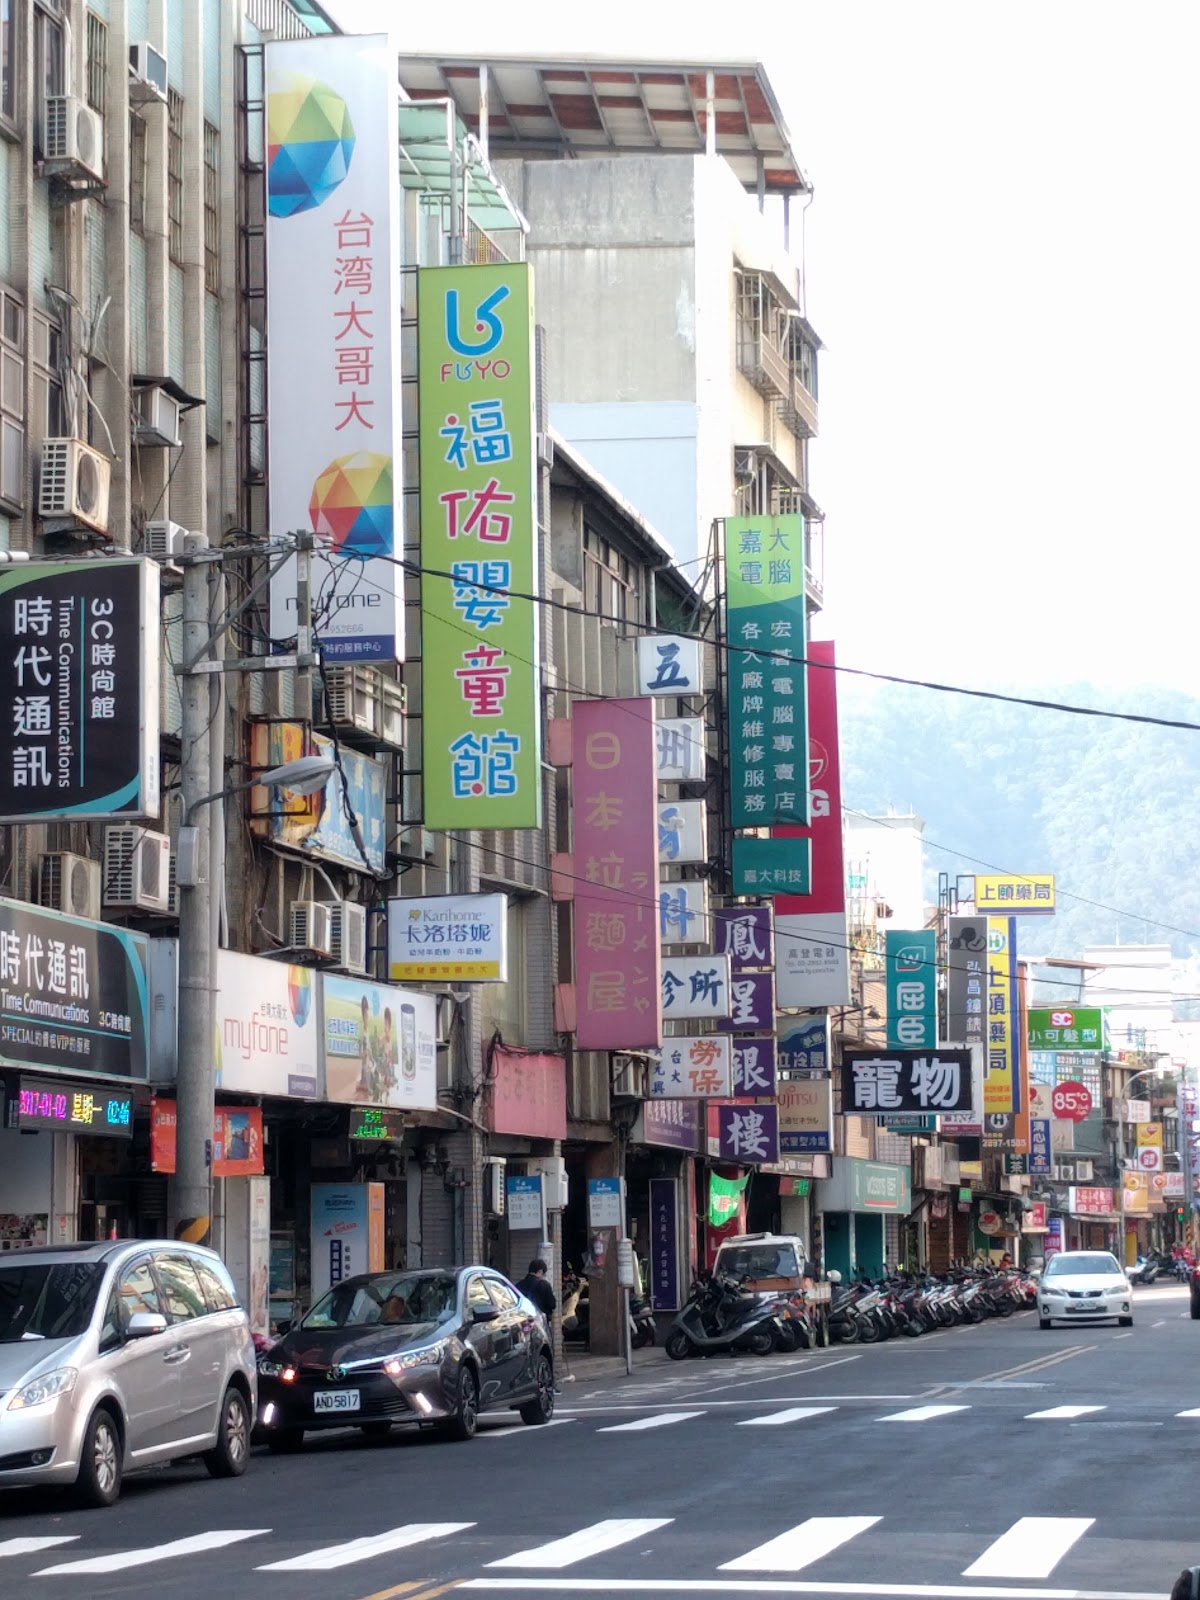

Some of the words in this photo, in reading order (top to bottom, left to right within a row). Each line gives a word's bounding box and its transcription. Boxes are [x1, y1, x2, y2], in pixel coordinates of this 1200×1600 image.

[441, 359, 510, 383] FUYO
[58, 596, 75, 639] Time
[286, 592, 382, 618] myone
[438, 399, 520, 799] 福佑嬰童館
[90, 598, 116, 720] 3C時尚館
[13, 596, 52, 788] 時代通訊
[58, 643, 75, 789] Communications
[740, 621, 767, 813] 各大廠牌維修服務
[770, 620, 796, 810] 宏碁電腦專賣店
[810, 788, 831, 818] G
[584, 731, 627, 1014] 日本拉麵屋
[744, 869, 803, 883] 嘉大科技
[400, 923, 492, 944] 卡洛塔妮
[0, 929, 90, 1000] 時代通訊
[1, 988, 22, 1012] Time
[23, 991, 90, 1025] Communications
[224, 1012, 289, 1061] myfone
[778, 1051, 825, 1068] 立冷氣
[689, 1040, 724, 1095] 勞保
[851, 1057, 961, 1109] 寵物
